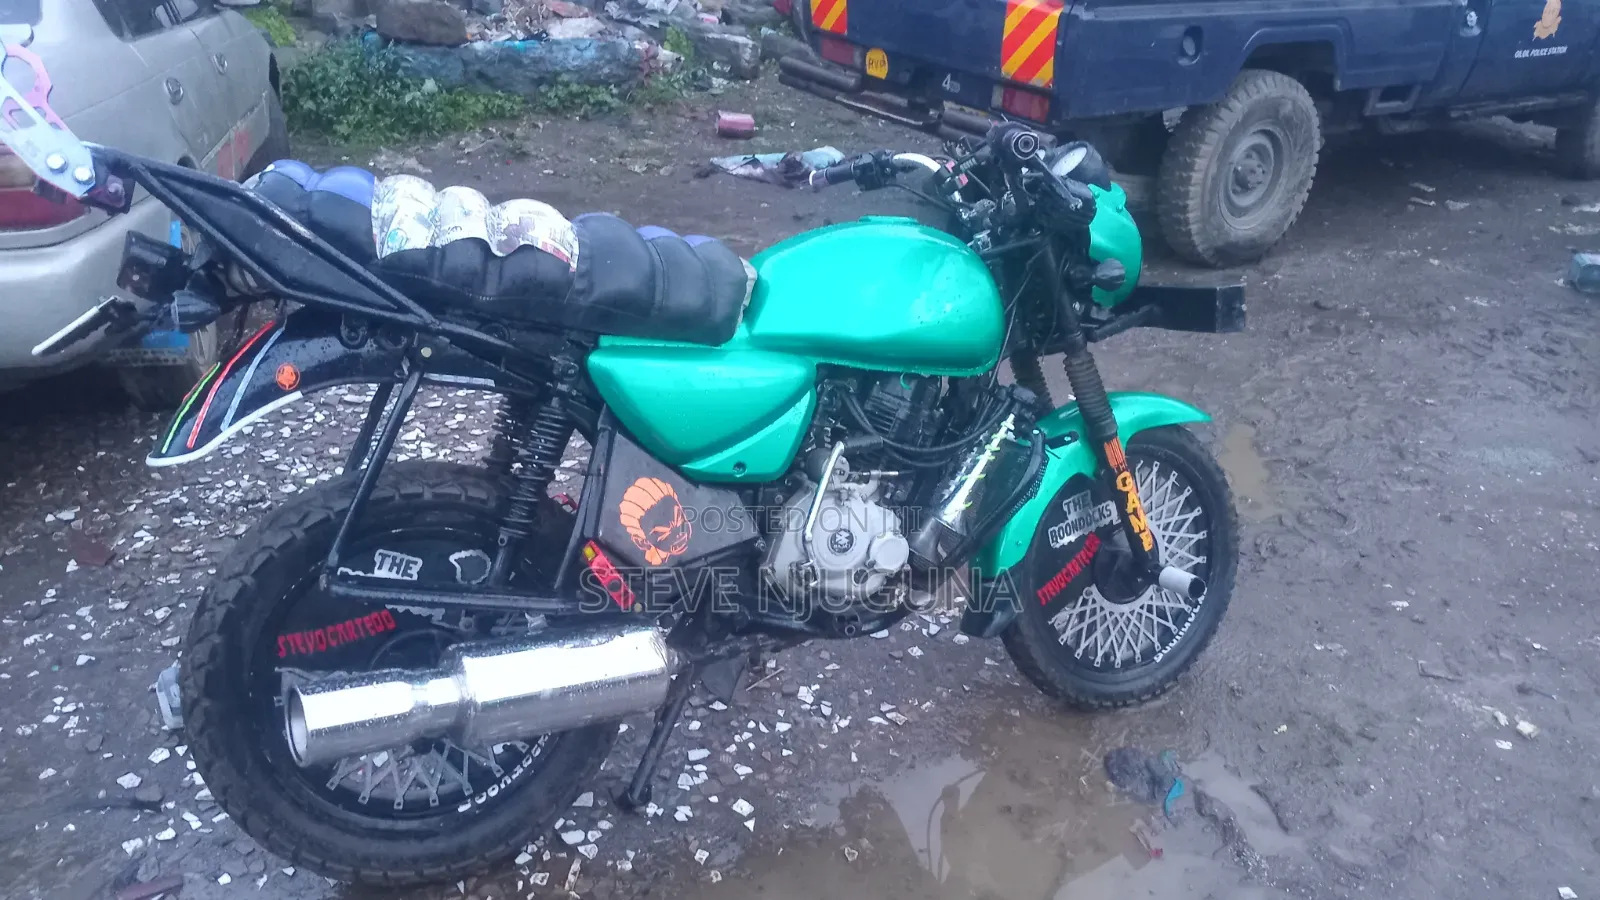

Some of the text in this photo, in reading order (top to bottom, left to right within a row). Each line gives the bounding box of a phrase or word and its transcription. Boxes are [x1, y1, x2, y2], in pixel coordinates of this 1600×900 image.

[1063, 490, 1092, 515] THE
[1049, 502, 1112, 545] BOONDOCKS
[377, 552, 420, 579] THE
